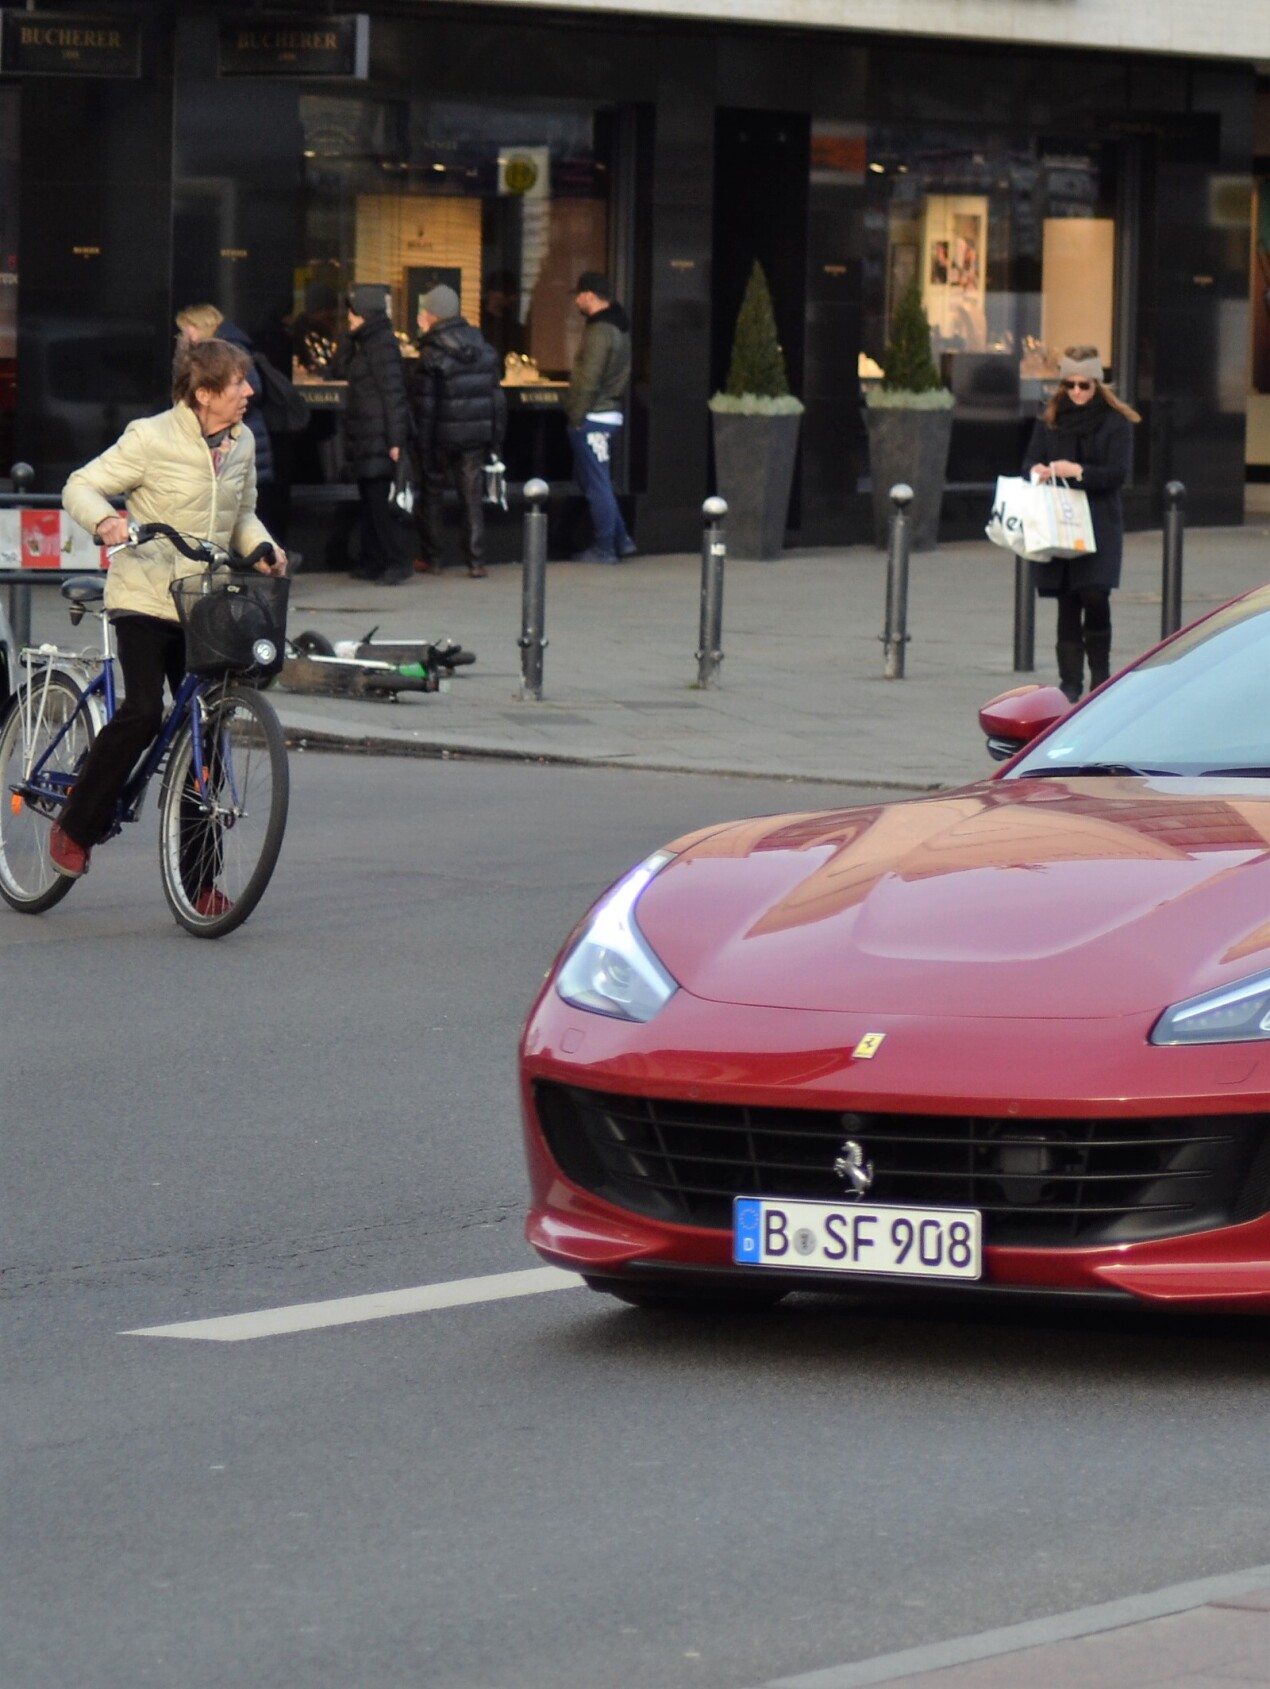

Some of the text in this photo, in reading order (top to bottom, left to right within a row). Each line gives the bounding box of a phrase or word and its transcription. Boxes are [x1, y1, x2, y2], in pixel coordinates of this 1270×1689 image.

[20, 27, 120, 47] BUCHERER
[237, 31, 337, 49] BUCHERER
[765, 1210, 971, 1267] B SF 908
